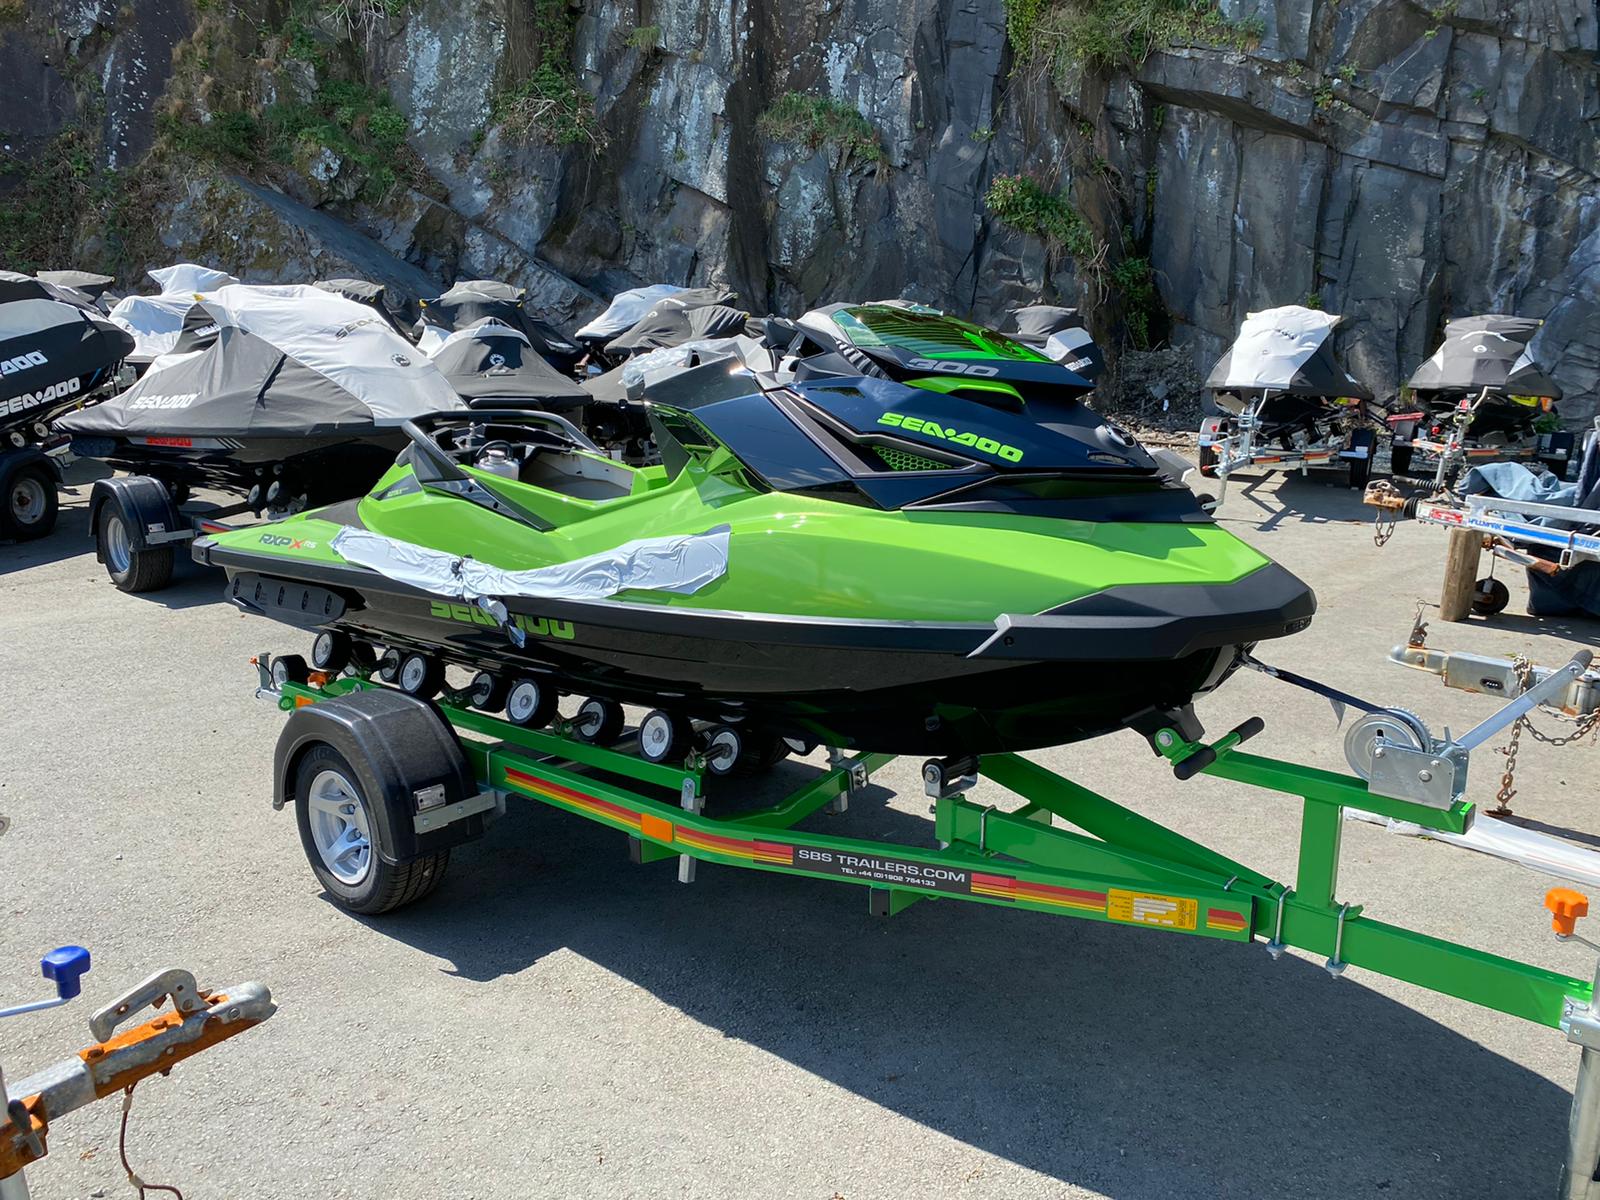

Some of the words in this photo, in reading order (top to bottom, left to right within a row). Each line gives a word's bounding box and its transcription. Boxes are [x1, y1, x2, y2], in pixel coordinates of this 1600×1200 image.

[906, 358, 999, 377] 300
[798, 849, 833, 862] SBS
[836, 854, 966, 883] TRAILERS.COM
[840, 867, 857, 875] TEL:
